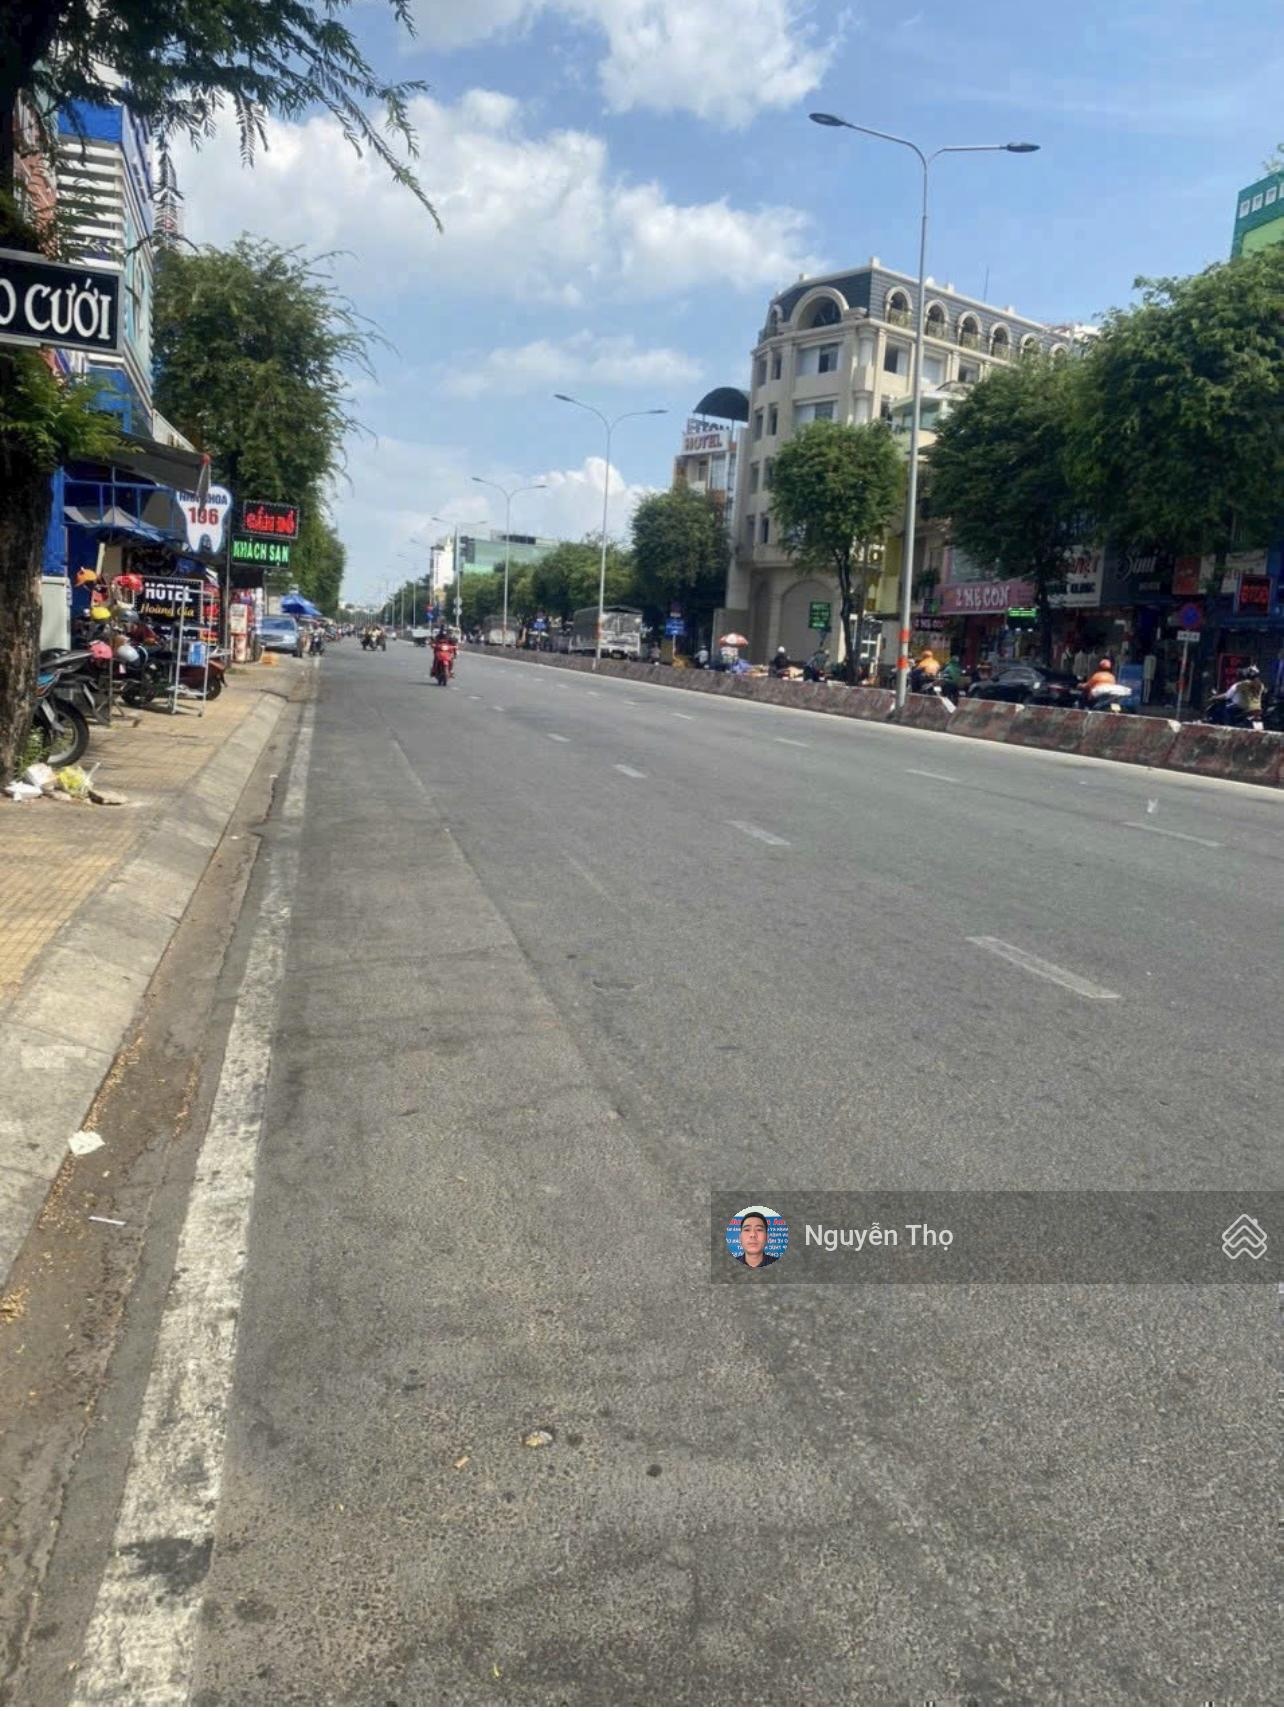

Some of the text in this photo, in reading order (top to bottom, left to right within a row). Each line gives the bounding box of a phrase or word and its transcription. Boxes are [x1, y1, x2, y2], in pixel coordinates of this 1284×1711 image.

[24, 278, 112, 340] CƯỚI
[232, 537, 290, 567] KHÁCH SẠN
[145, 582, 193, 602] HOTEL
